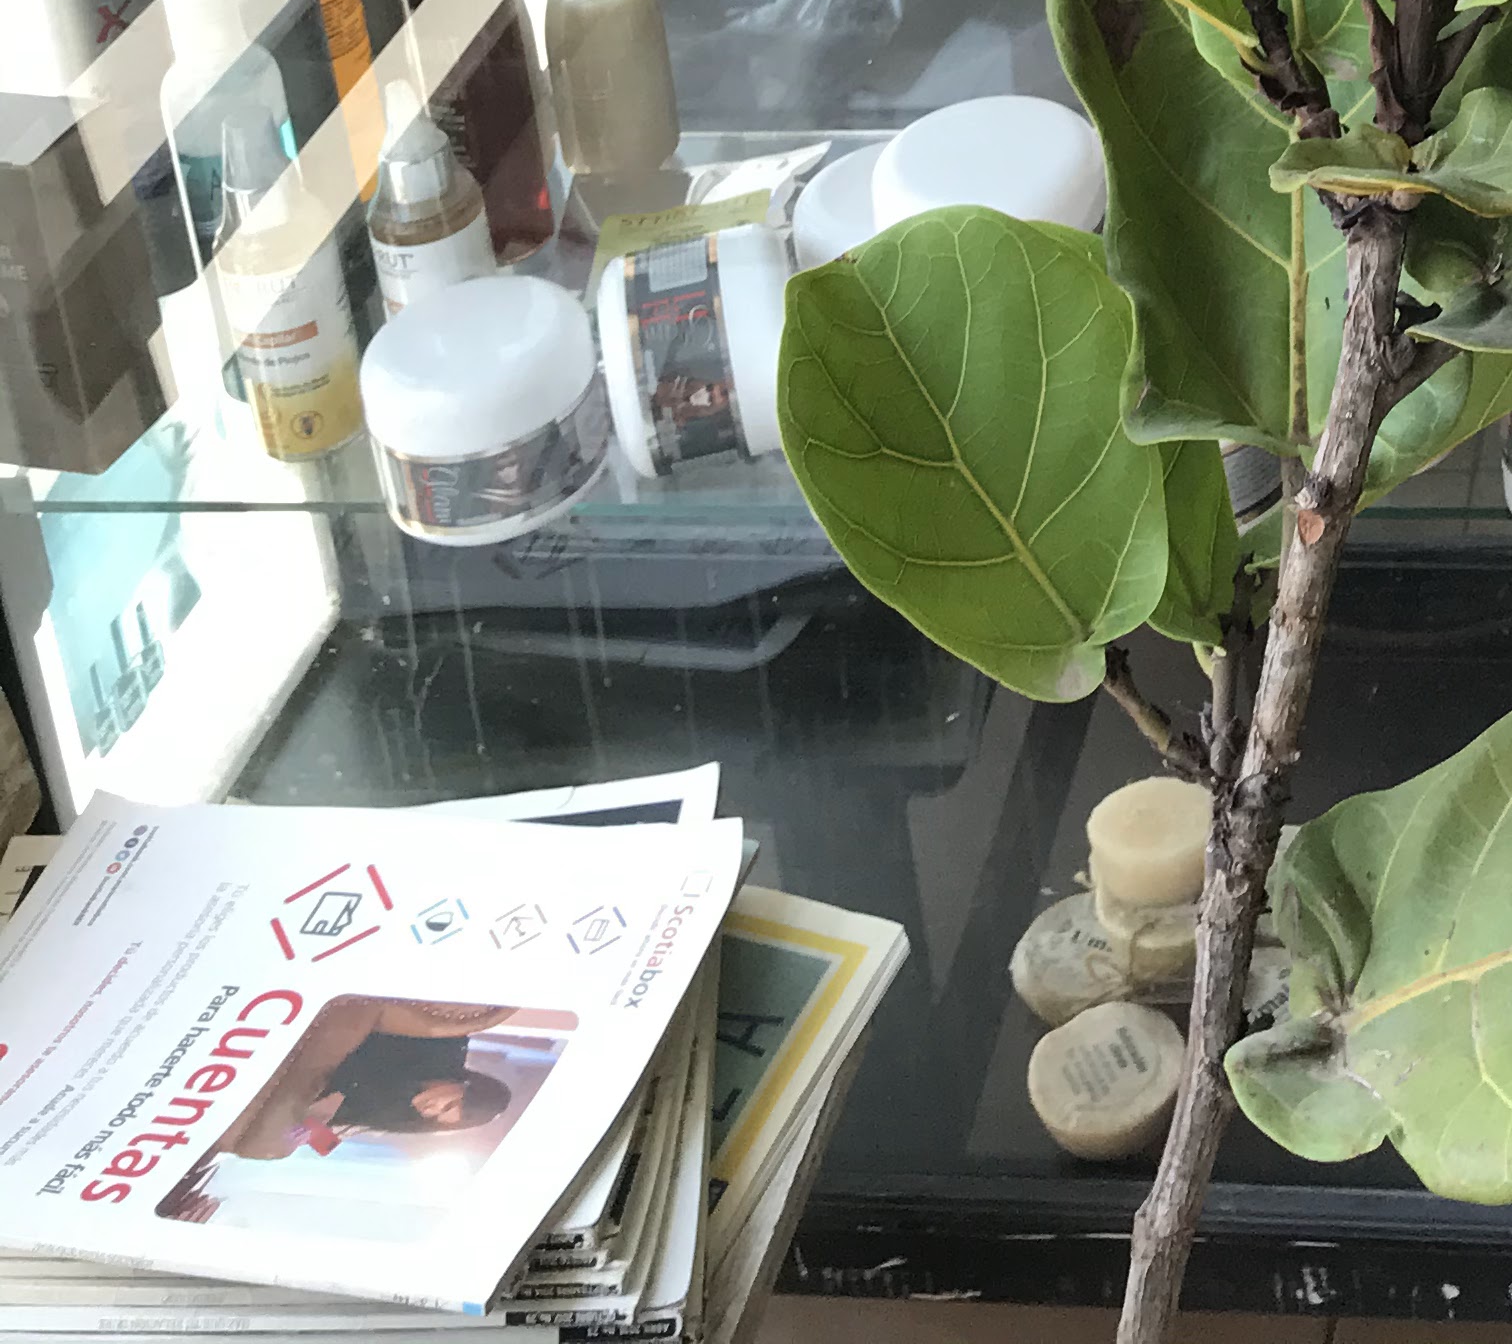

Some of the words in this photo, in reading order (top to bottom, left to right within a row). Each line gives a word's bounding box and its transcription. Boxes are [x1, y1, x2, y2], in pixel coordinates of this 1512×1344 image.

[624, 907, 694, 1007] Scotiabox
[196, 981, 240, 1025] Para
[143, 1022, 207, 1092] hacerte
[79, 989, 304, 1206] Cuentas
[107, 1087, 154, 1131] todo
[73, 1124, 113, 1164] más
